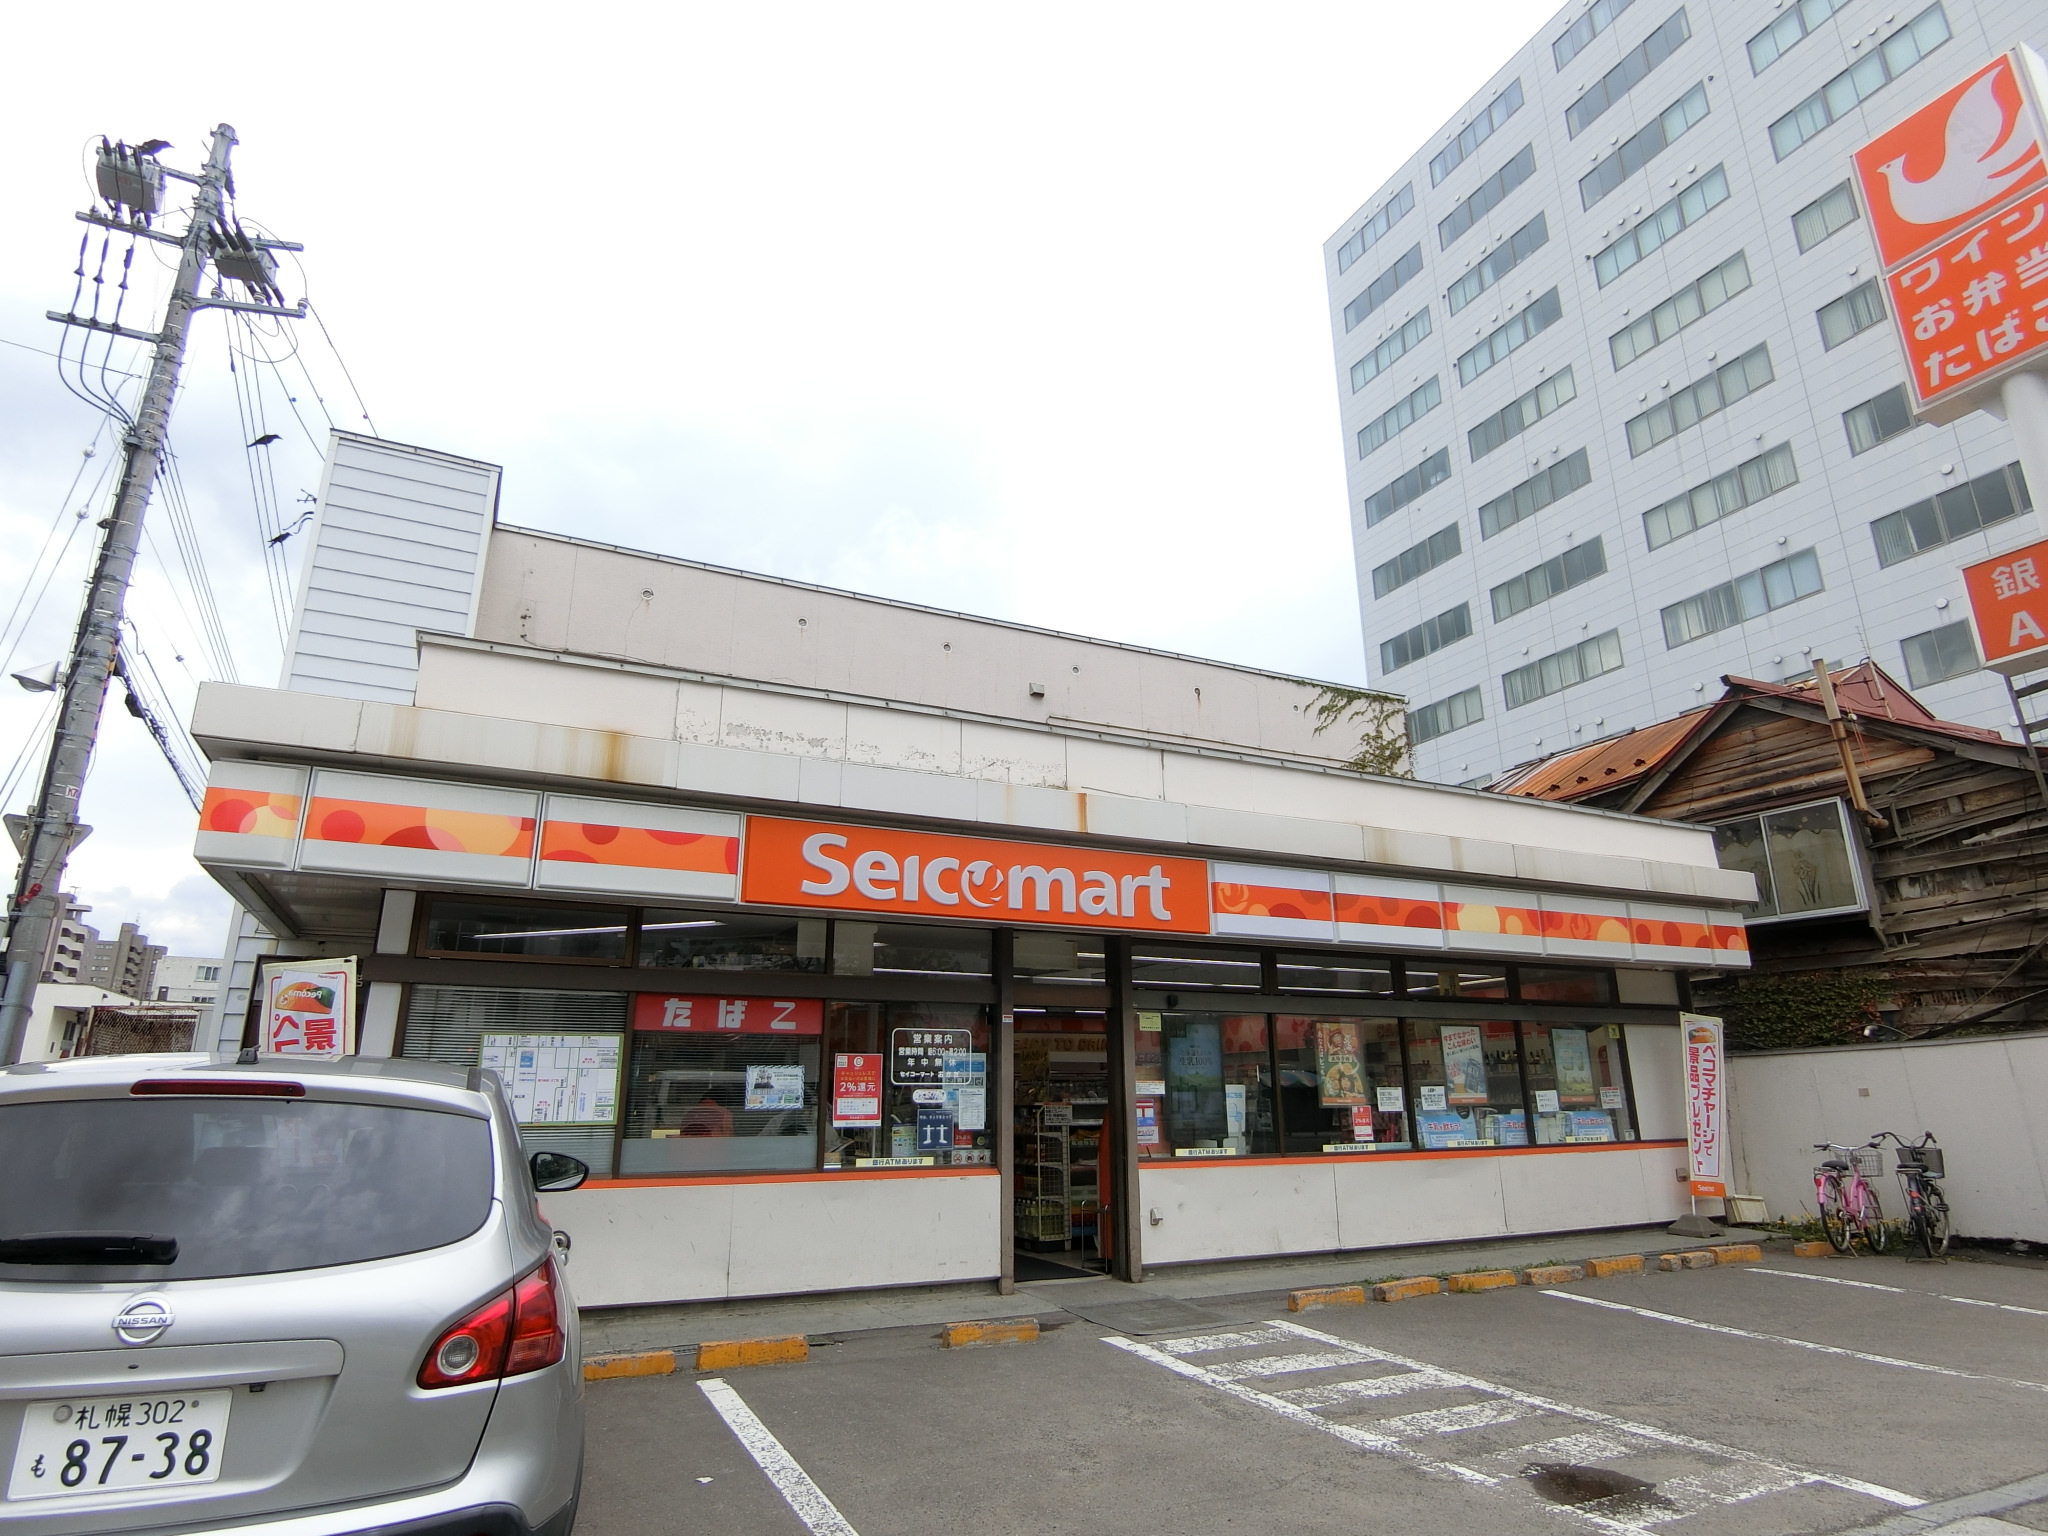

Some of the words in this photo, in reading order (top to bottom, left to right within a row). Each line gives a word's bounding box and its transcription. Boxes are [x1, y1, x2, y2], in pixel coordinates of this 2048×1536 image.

[1900, 202, 2045, 295] ワイン
[1990, 557, 2041, 601] 銀
[801, 832, 1171, 921] Seicomart
[662, 998, 797, 1030] たばこ
[913, 1033, 953, 1044] 営業案内
[907, 1058, 956, 1067] 年中無休
[840, 1082, 876, 1092] 2%還元
[118, 1316, 168, 1325] NISSAN
[31, 1453, 46, 1479] も
[60, 1428, 213, 1488] 87-38
